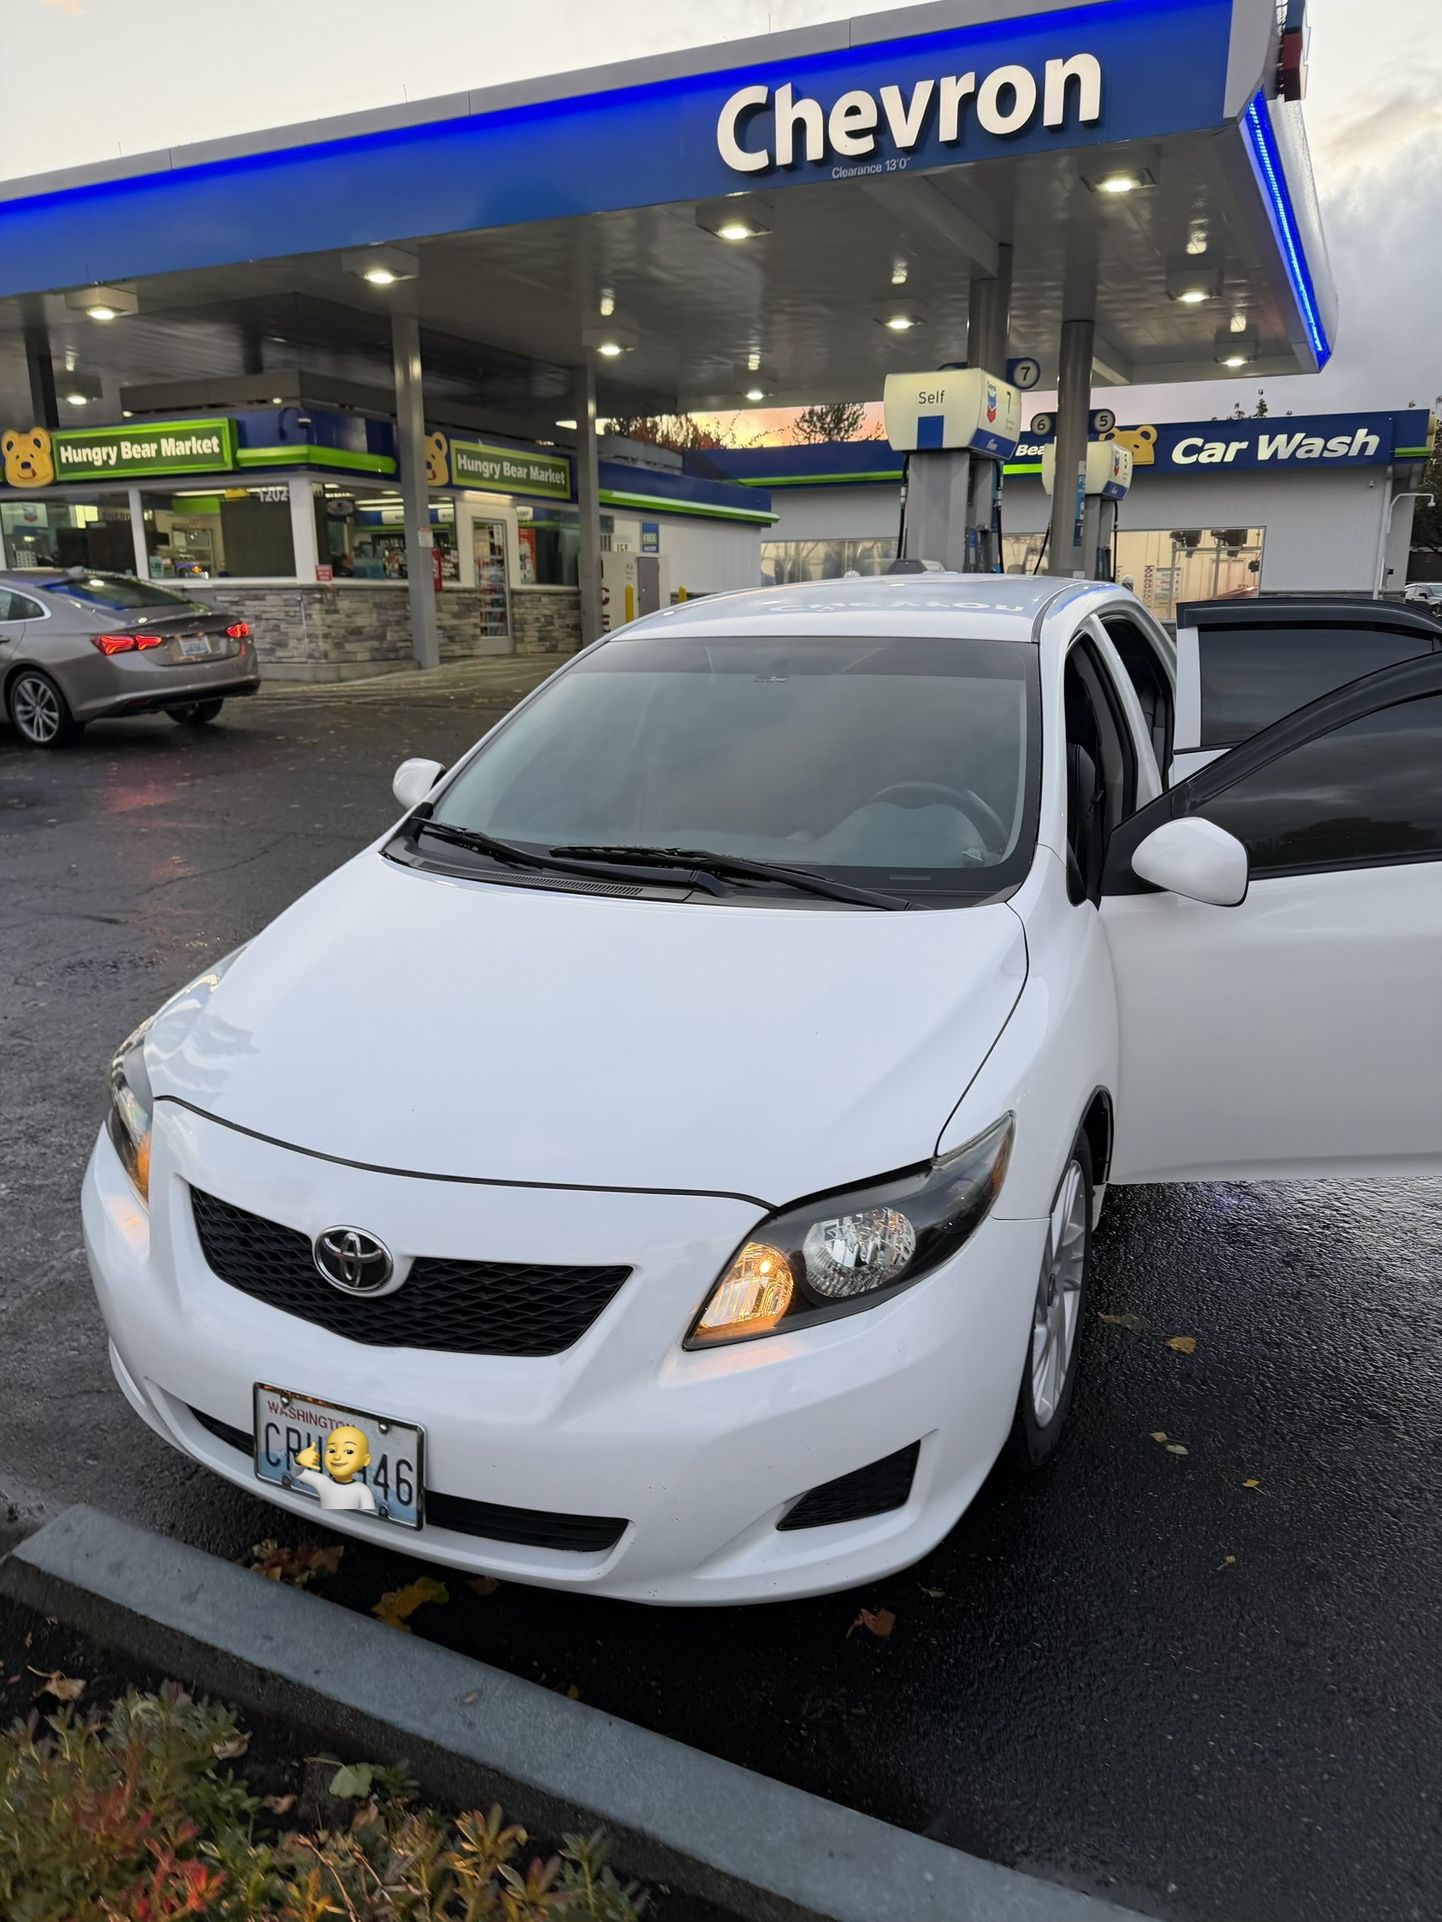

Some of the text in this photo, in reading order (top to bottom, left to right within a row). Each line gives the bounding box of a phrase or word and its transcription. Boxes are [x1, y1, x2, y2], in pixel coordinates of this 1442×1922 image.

[717, 52, 1101, 173] Chevron
[832, 163, 882, 179] Clearance
[1020, 366, 1031, 381] 7
[918, 389, 946, 404] Self
[1036, 419, 1046, 431] 6
[1099, 415, 1108, 427] 5
[60, 436, 220, 466] Hungry Bear Market
[1172, 427, 1380, 465] Car Wash
[457, 453, 566, 486] Hungry Bear Market
